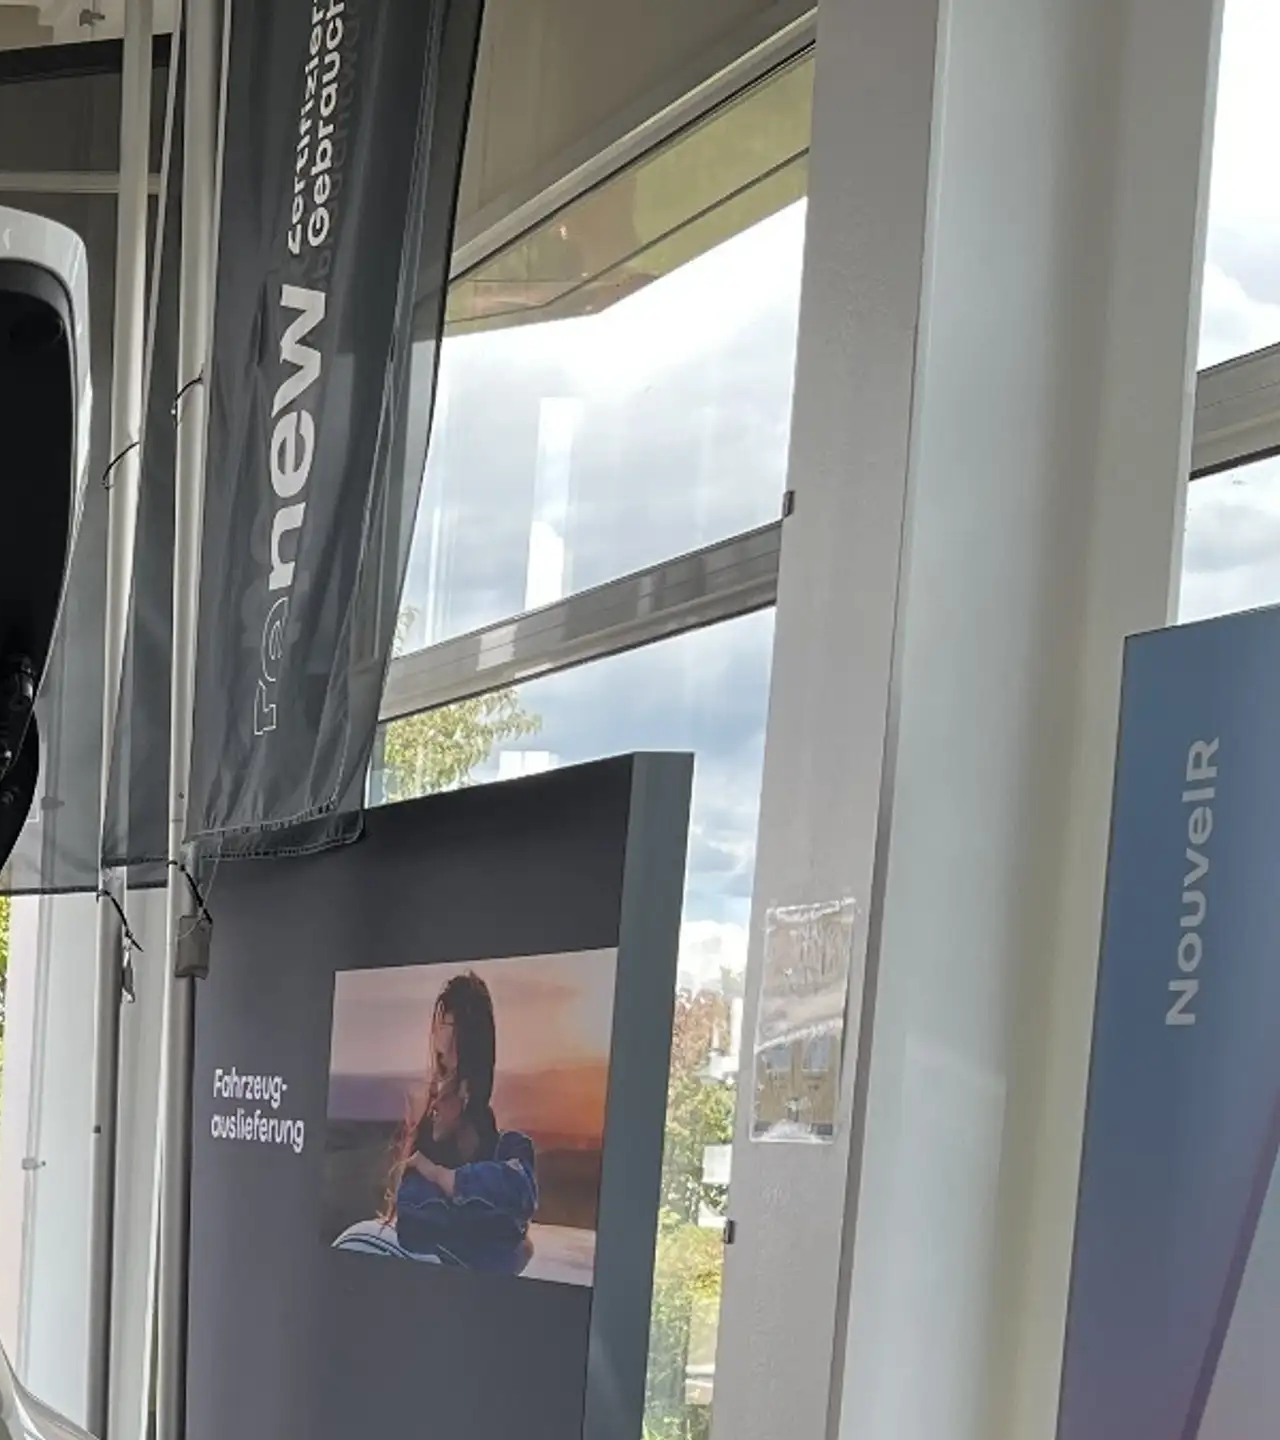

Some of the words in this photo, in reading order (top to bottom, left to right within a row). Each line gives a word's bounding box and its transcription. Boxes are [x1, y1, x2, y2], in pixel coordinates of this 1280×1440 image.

[288, 0, 325, 255] Zertifizier
[254, 283, 327, 736] renew
[211, 1108, 305, 1153] auslieferung
[213, 1067, 288, 1110] Fahrzeug-
